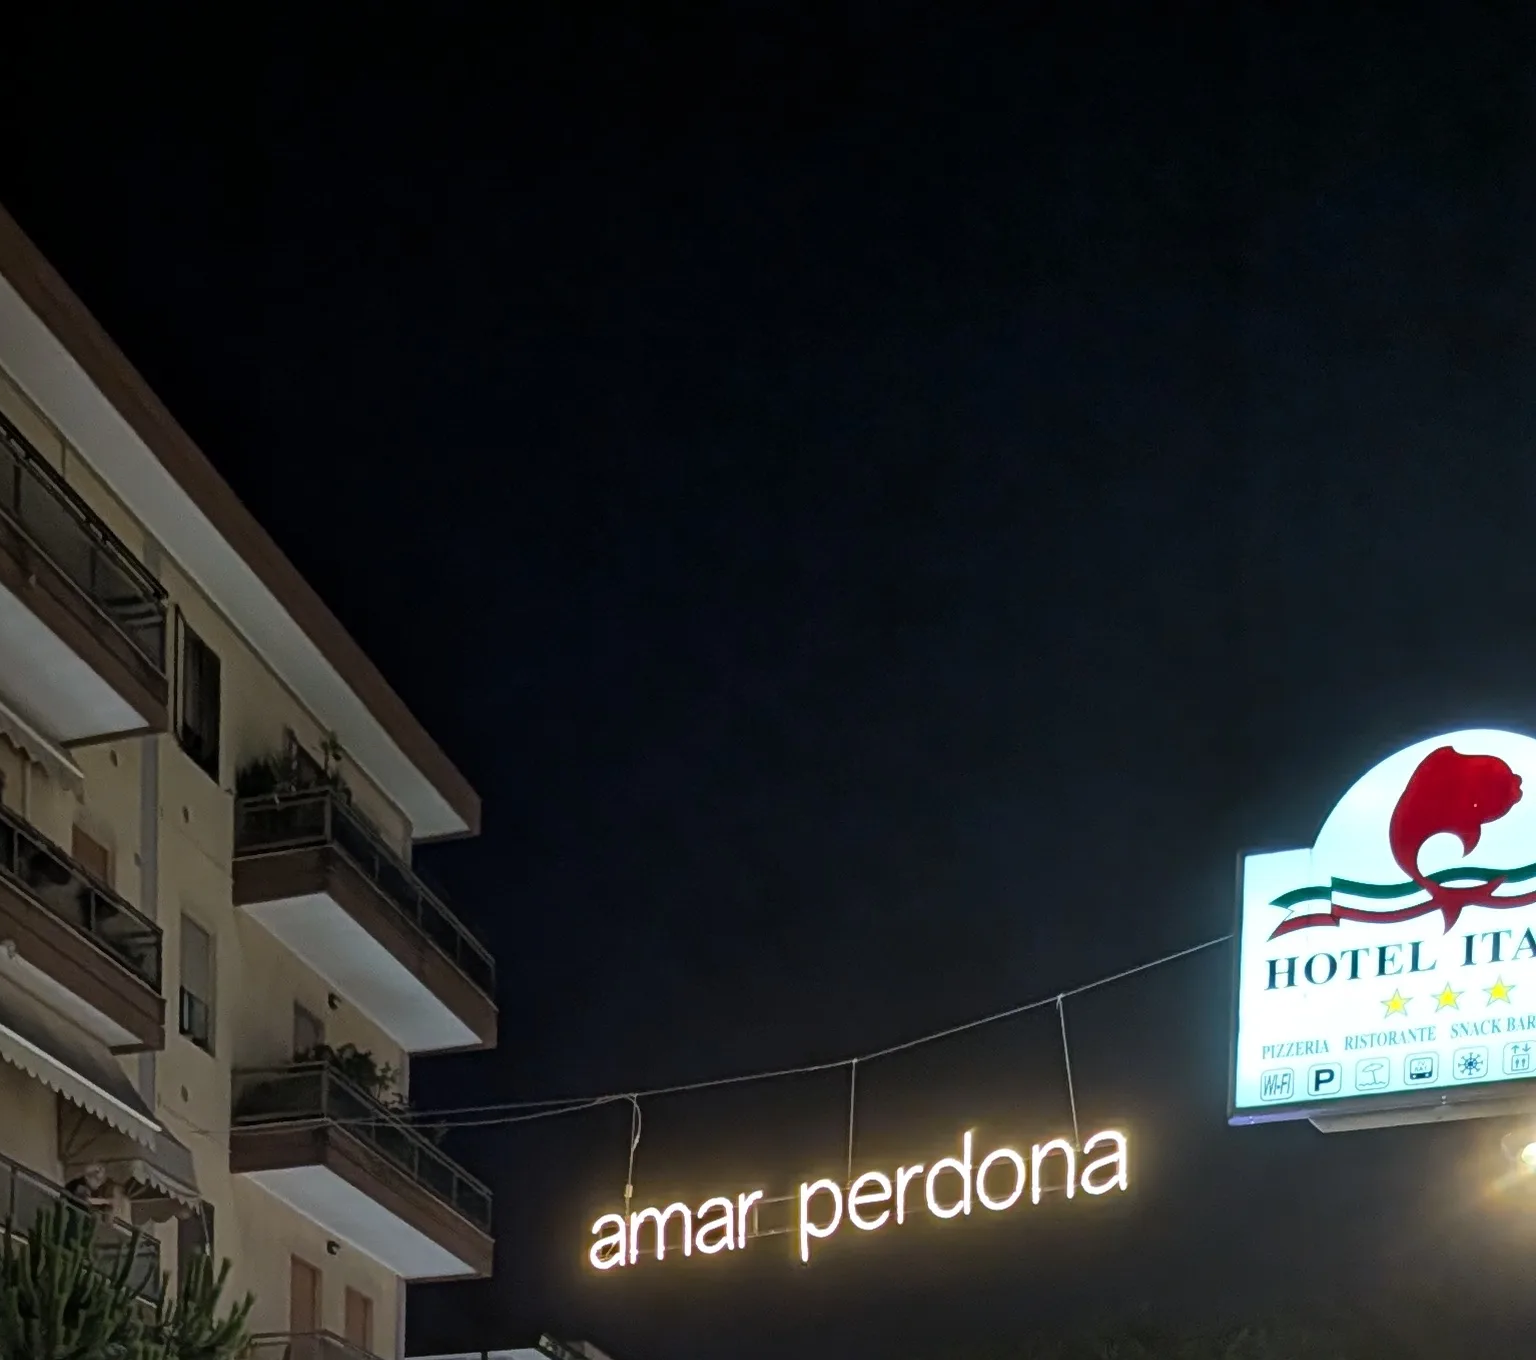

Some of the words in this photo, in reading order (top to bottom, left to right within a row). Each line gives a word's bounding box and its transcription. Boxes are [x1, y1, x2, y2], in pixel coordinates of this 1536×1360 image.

[1264, 941, 1437, 990] HOTEL
[1262, 1039, 1330, 1060] PIZZERIA
[1344, 1025, 1437, 1051] RISTORANTE
[1450, 1018, 1502, 1039] SNACK
[1507, 1014, 1536, 1032] BAR
[1264, 1072, 1292, 1096] WI-FI
[1314, 1069, 1335, 1092] P
[589, 1189, 764, 1270] amar
[798, 1128, 1128, 1263] perdona
